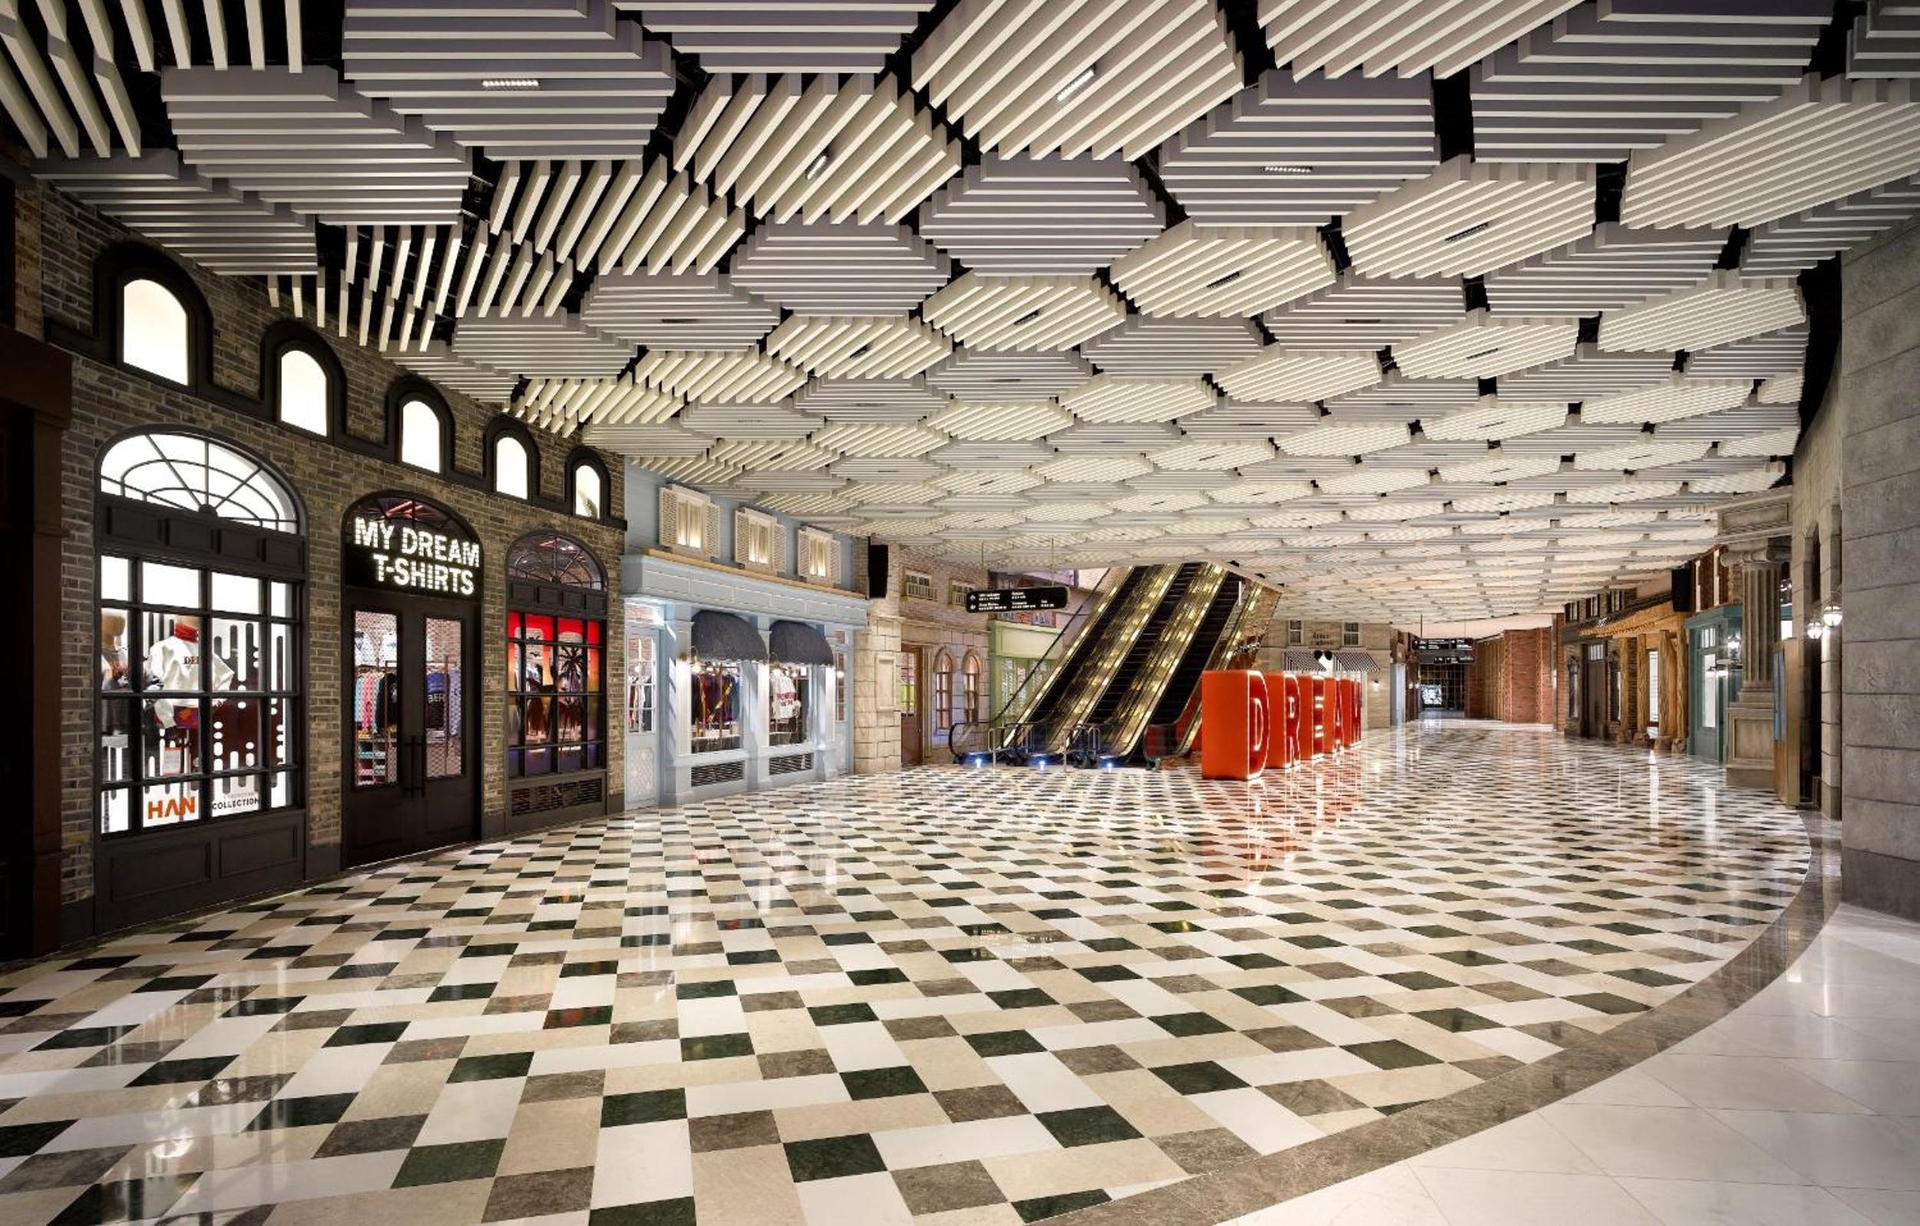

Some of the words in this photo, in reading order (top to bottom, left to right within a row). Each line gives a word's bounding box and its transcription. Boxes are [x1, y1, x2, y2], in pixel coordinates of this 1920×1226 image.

[355, 516, 395, 550] MY
[401, 526, 480, 568] DREAM
[373, 553, 475, 596] T-SHIRTS
[1201, 670, 1362, 781] DREAM
[147, 796, 196, 820] HAN
